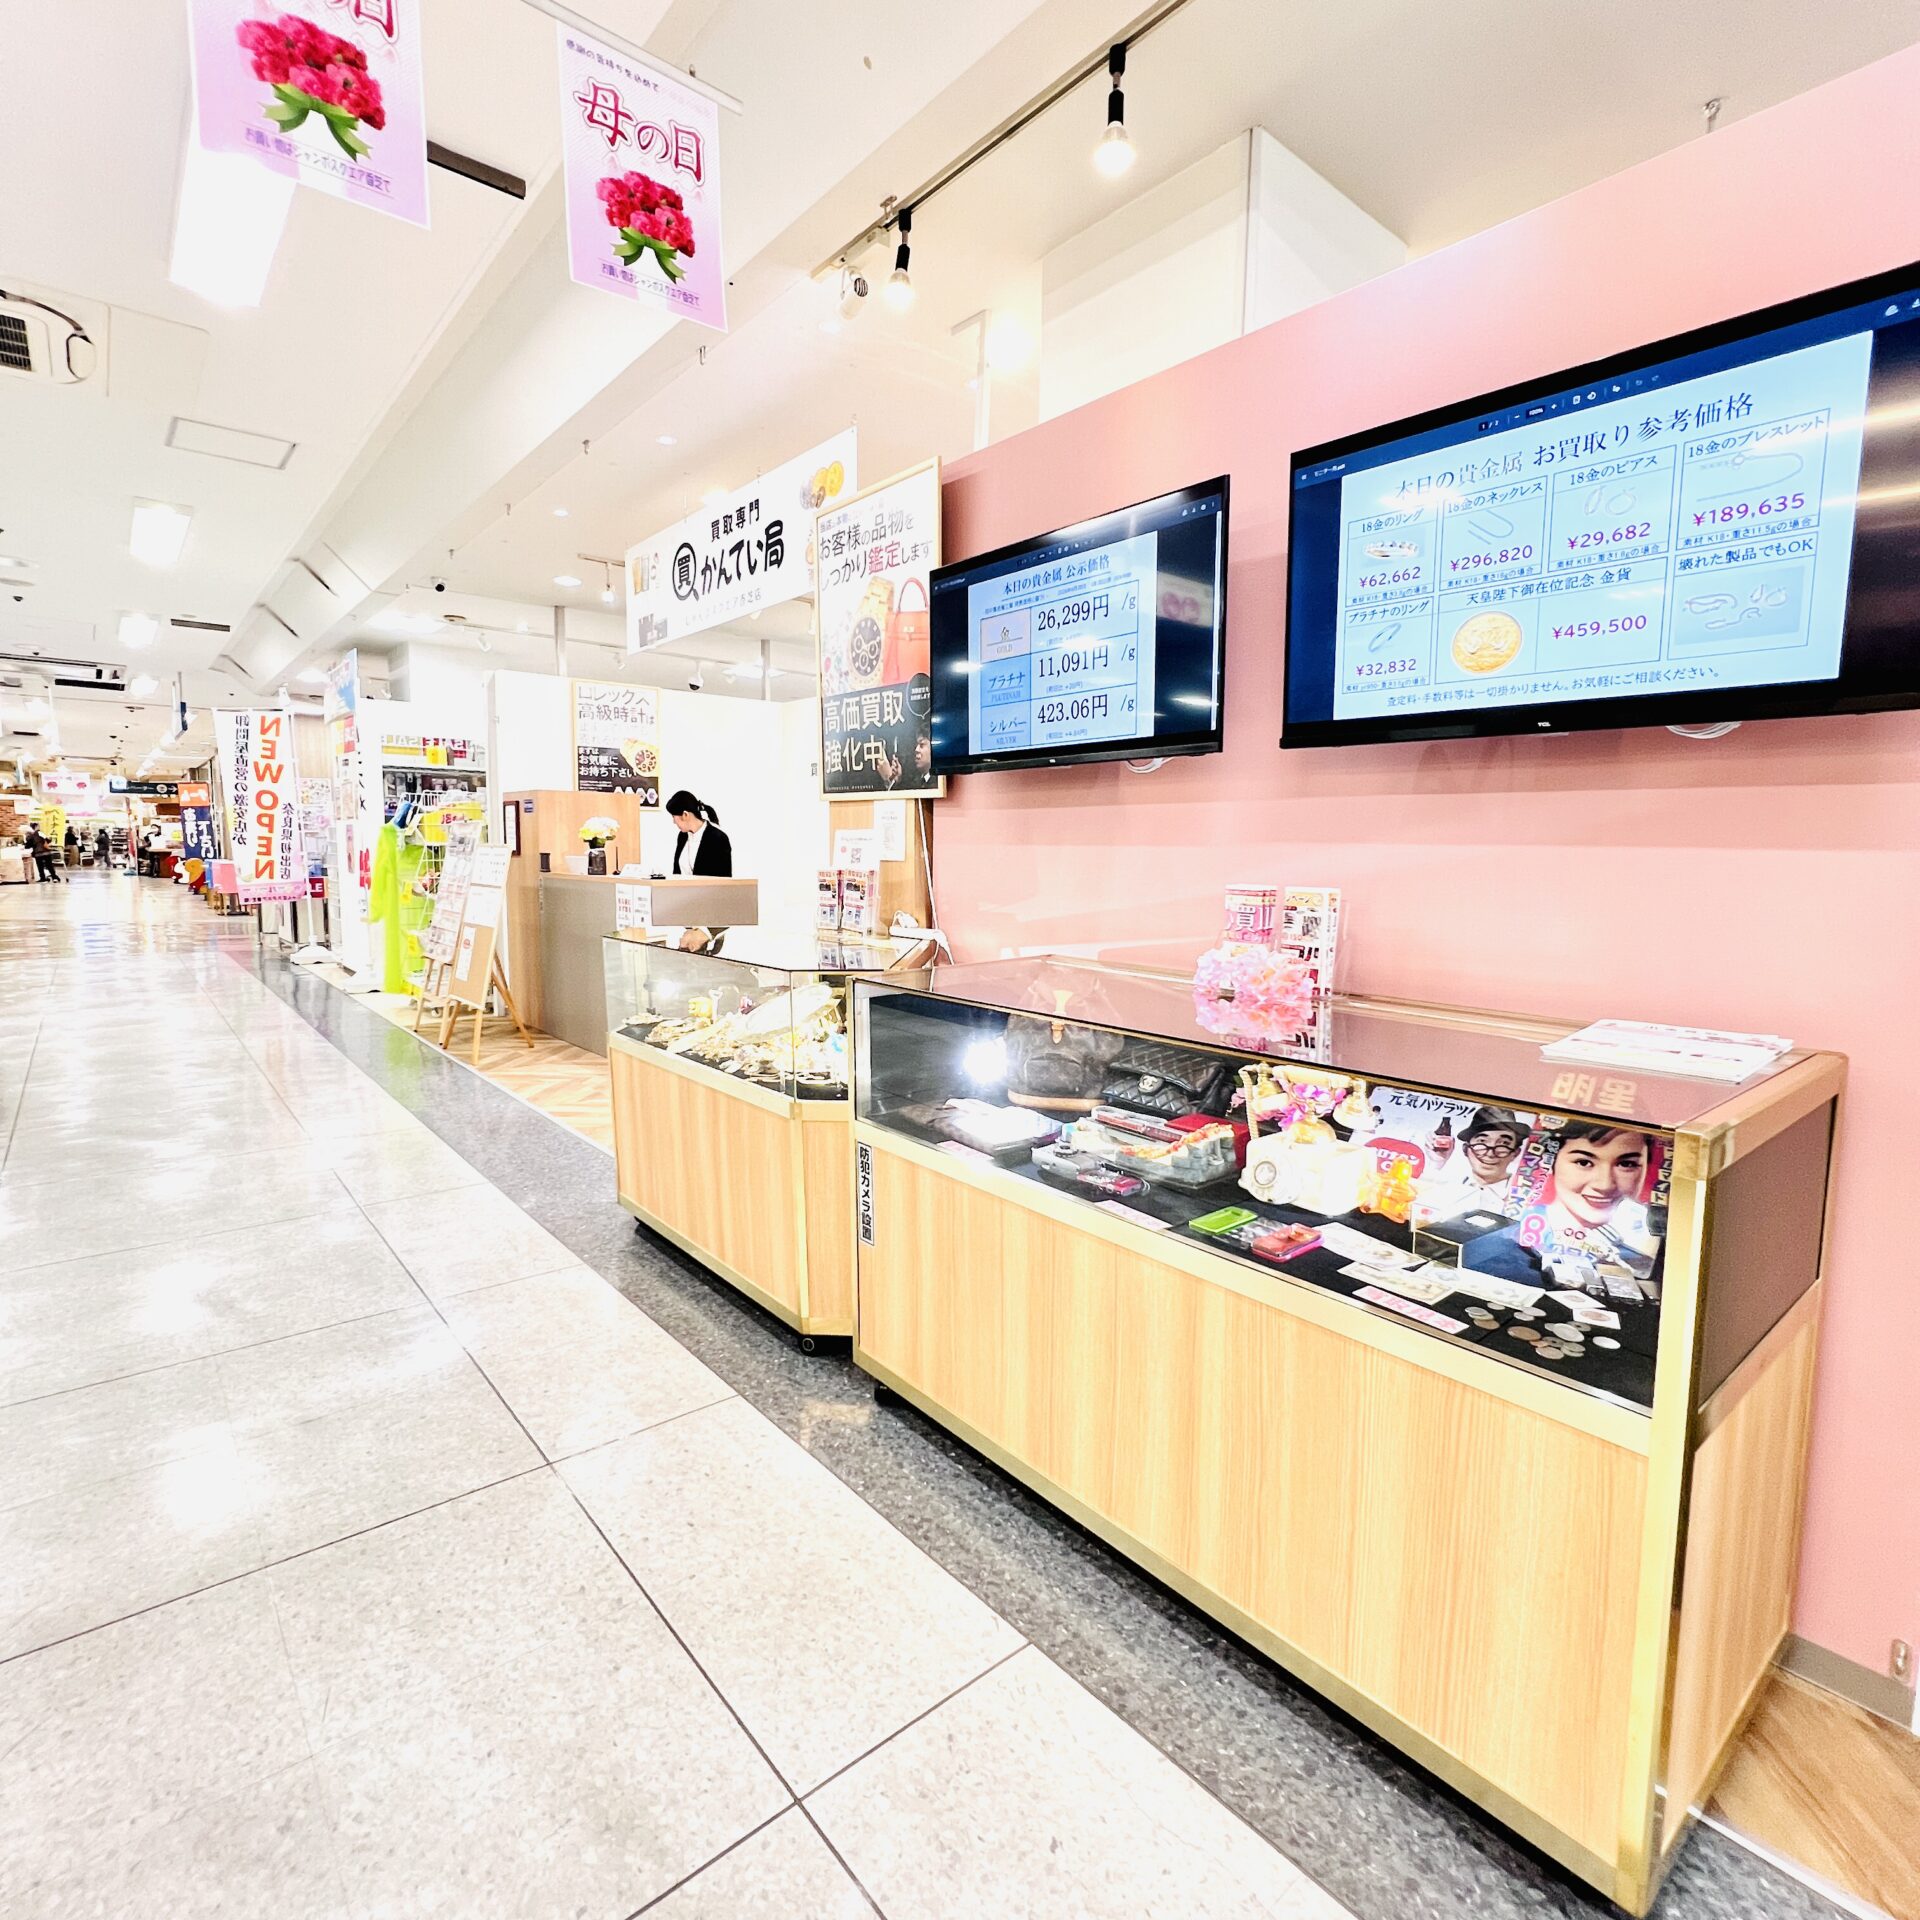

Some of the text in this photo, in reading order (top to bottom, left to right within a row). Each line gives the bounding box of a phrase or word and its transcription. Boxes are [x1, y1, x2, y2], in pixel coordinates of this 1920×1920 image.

[576, 82, 703, 183] 母の日
[1689, 415, 1825, 458] 18金のブレスレット
[1394, 450, 1523, 498] 本日の貴金属
[1570, 455, 1658, 486] 18金のピアス
[1448, 482, 1543, 513] 18金のネックレス
[1693, 492, 1805, 526] ¥189,635
[711, 498, 760, 542] 買取専門
[819, 508, 915, 561] お客様の品物を
[1362, 507, 1424, 533] 18金のリング
[1568, 522, 1651, 550] ¥29,682
[701, 519, 785, 596] かんてい局
[820, 540, 933, 592] しっかり鑑定します
[1450, 545, 1533, 571] ¥296,820
[1678, 538, 1814, 571] 壊れた製品でもOK
[1003, 567, 1062, 595] 本日の貴金属
[1360, 566, 1421, 588] ¥62,662
[1466, 567, 1632, 606] 天皇陛下御在位記念 金貨
[1038, 593, 1109, 632] 26,299円
[1121, 592, 1137, 612] /g
[1349, 600, 1429, 624] プラチナのリング
[1552, 615, 1647, 640] ¥459,500
[1039, 643, 1136, 679] 11,091円 /g
[1356, 658, 1416, 677] ¥32,832
[988, 671, 1026, 689] プラチナ
[578, 702, 655, 725] 高級時計は
[823, 689, 905, 736] 高価買取
[989, 717, 1027, 733] シルバー
[1037, 693, 1135, 724] 423.06円 /g
[1551, 1071, 1639, 1115] 明星
[860, 1146, 872, 1241] 防犯カメラ設置
